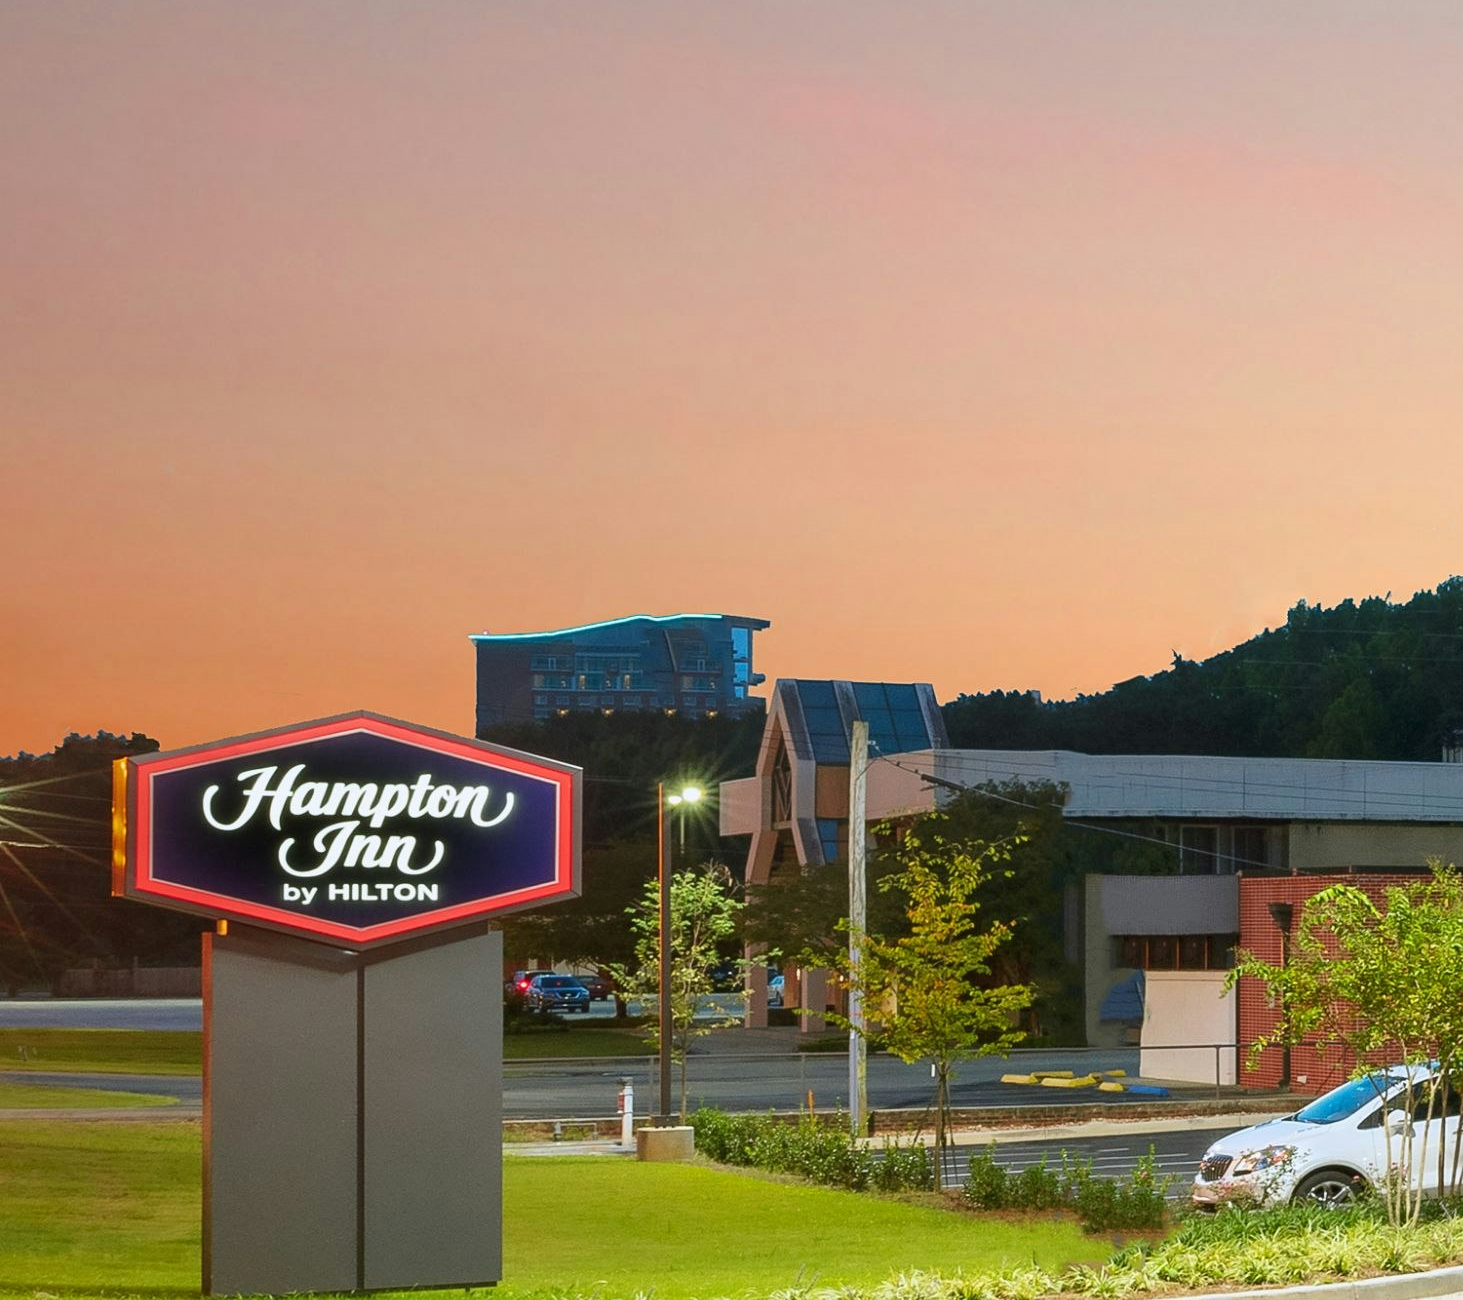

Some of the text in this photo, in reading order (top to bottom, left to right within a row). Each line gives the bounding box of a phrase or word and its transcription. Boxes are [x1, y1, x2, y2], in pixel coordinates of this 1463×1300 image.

[202, 763, 515, 831] Hampton
[278, 820, 445, 878] Inn
[283, 883, 439, 905] by HILTON
